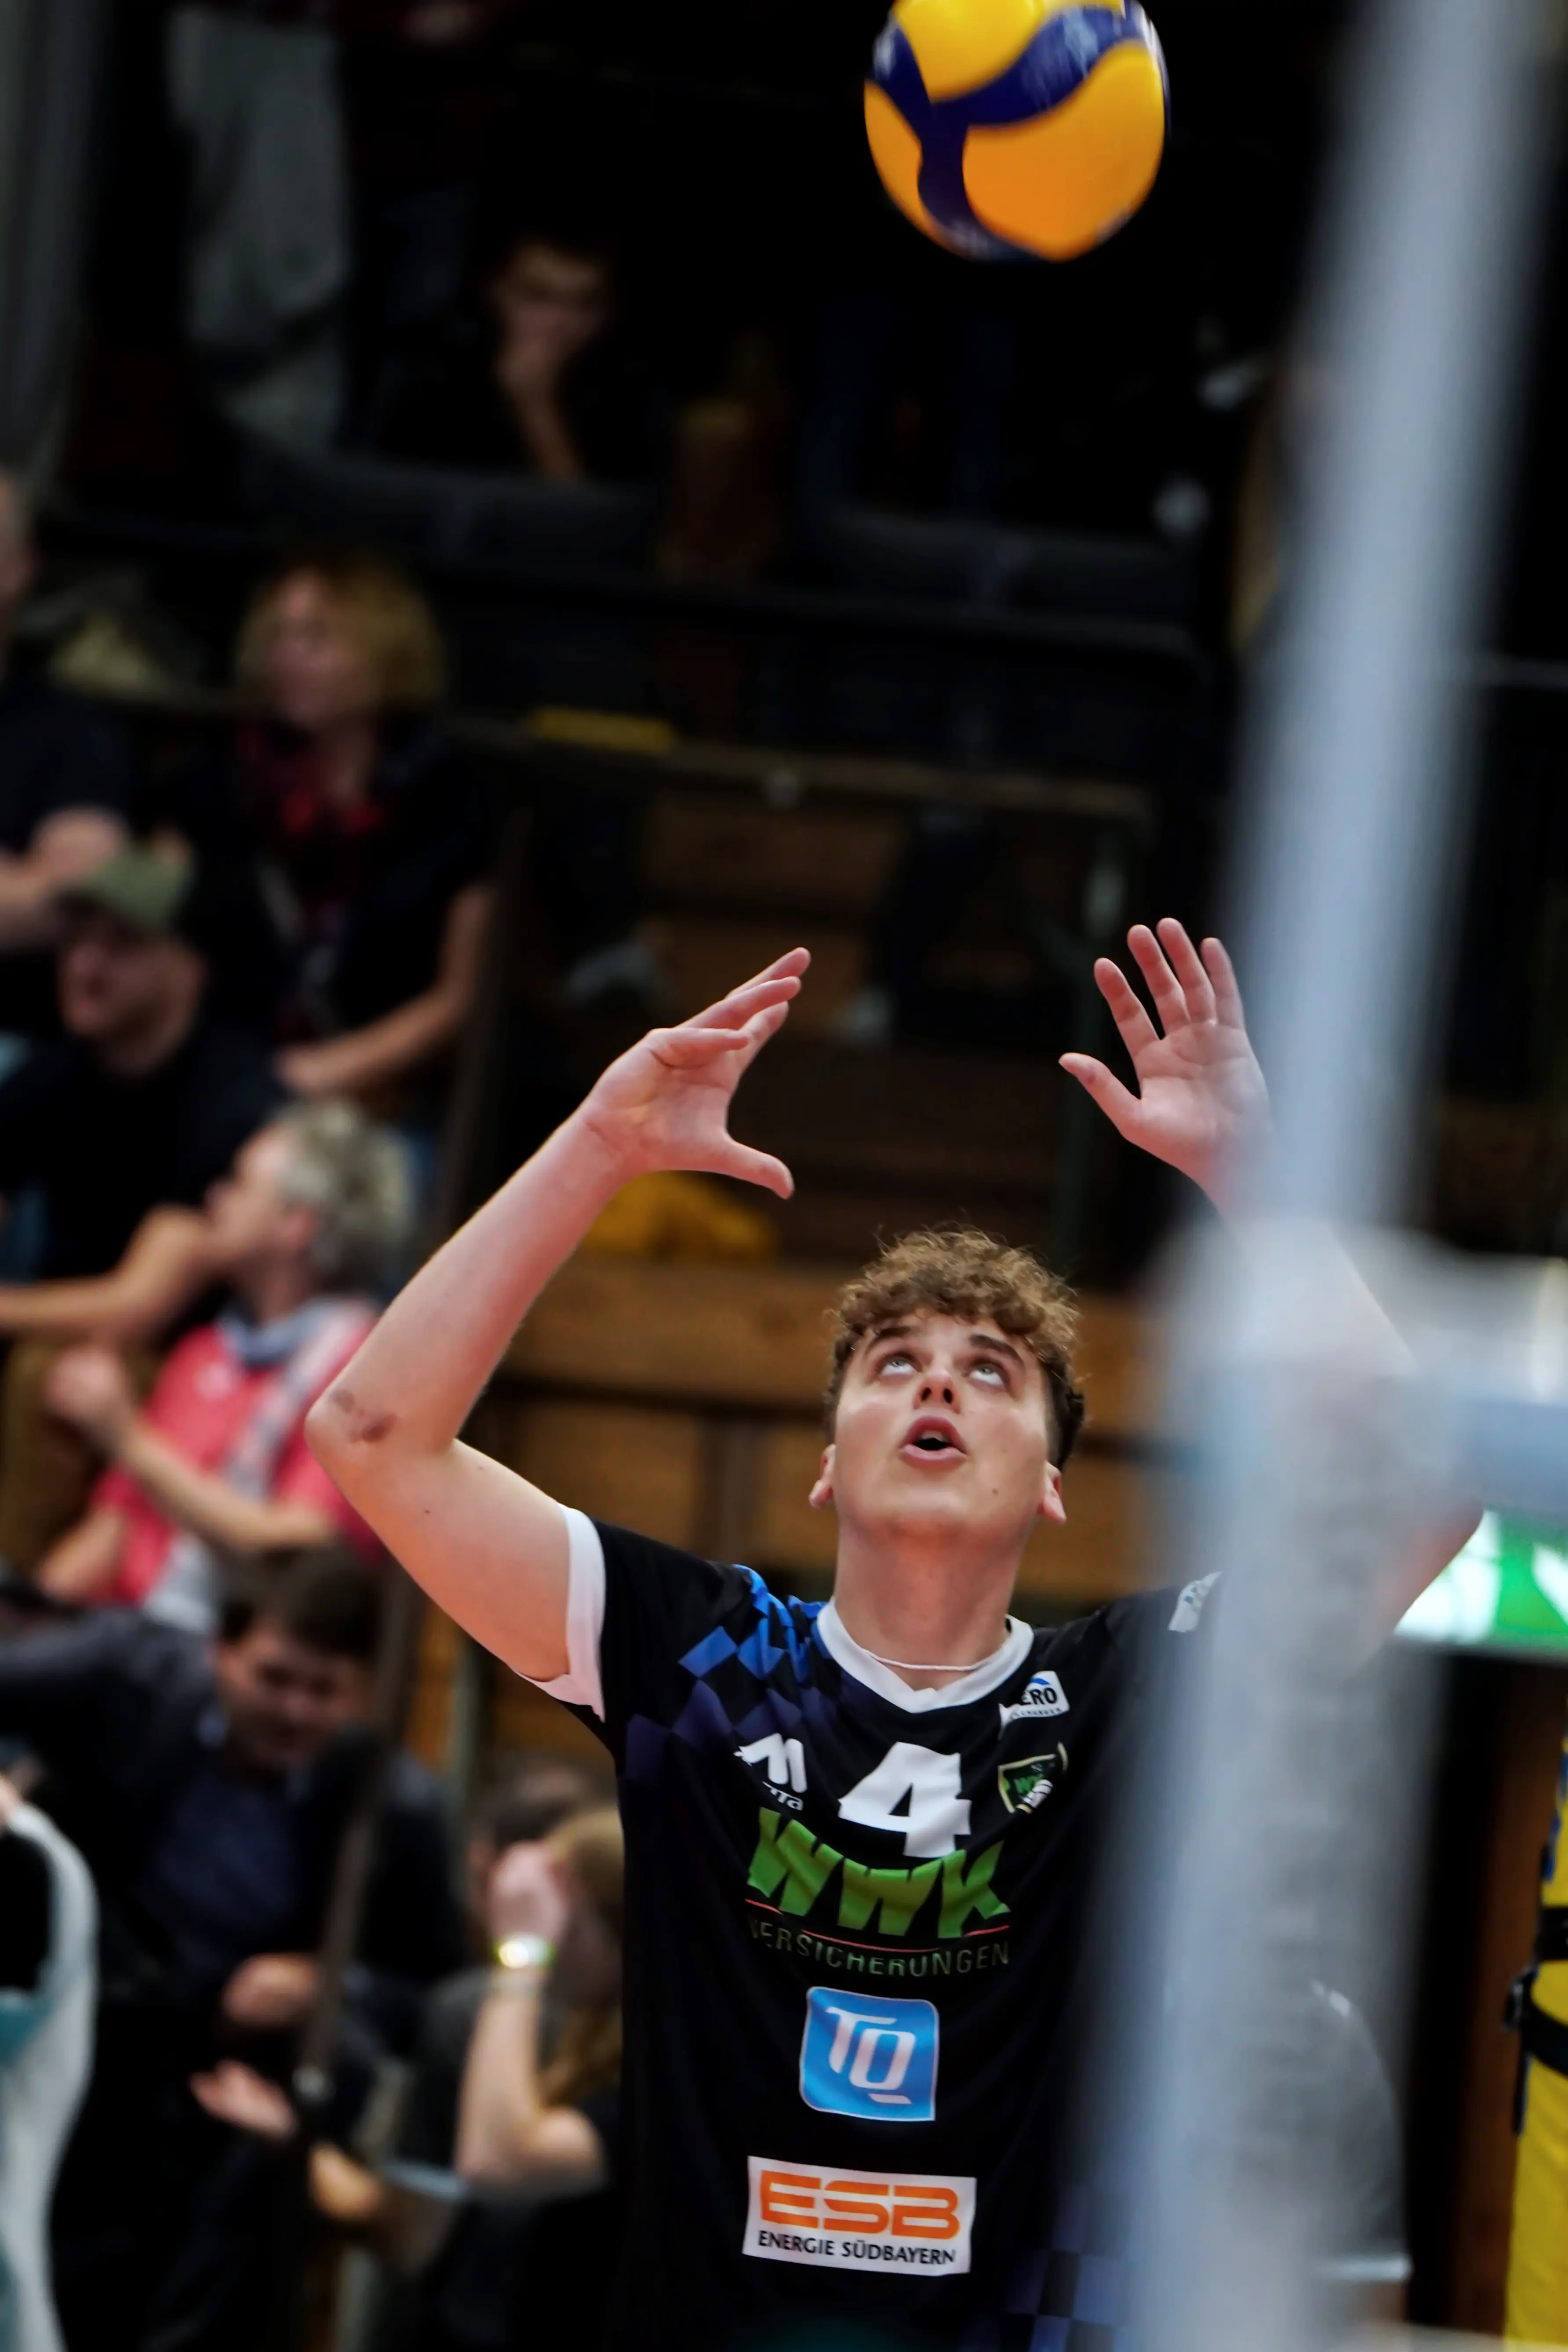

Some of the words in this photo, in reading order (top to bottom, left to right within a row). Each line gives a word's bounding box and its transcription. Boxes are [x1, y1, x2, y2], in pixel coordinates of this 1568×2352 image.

[837, 1741, 972, 1858] 4
[747, 1807, 1010, 1939] WWK
[825, 2006, 917, 2104] TQ
[758, 2230, 835, 2256] ENERGIE
[840, 2239, 956, 2265] SÜDBAYERN
[760, 2169, 961, 2240] ESB
